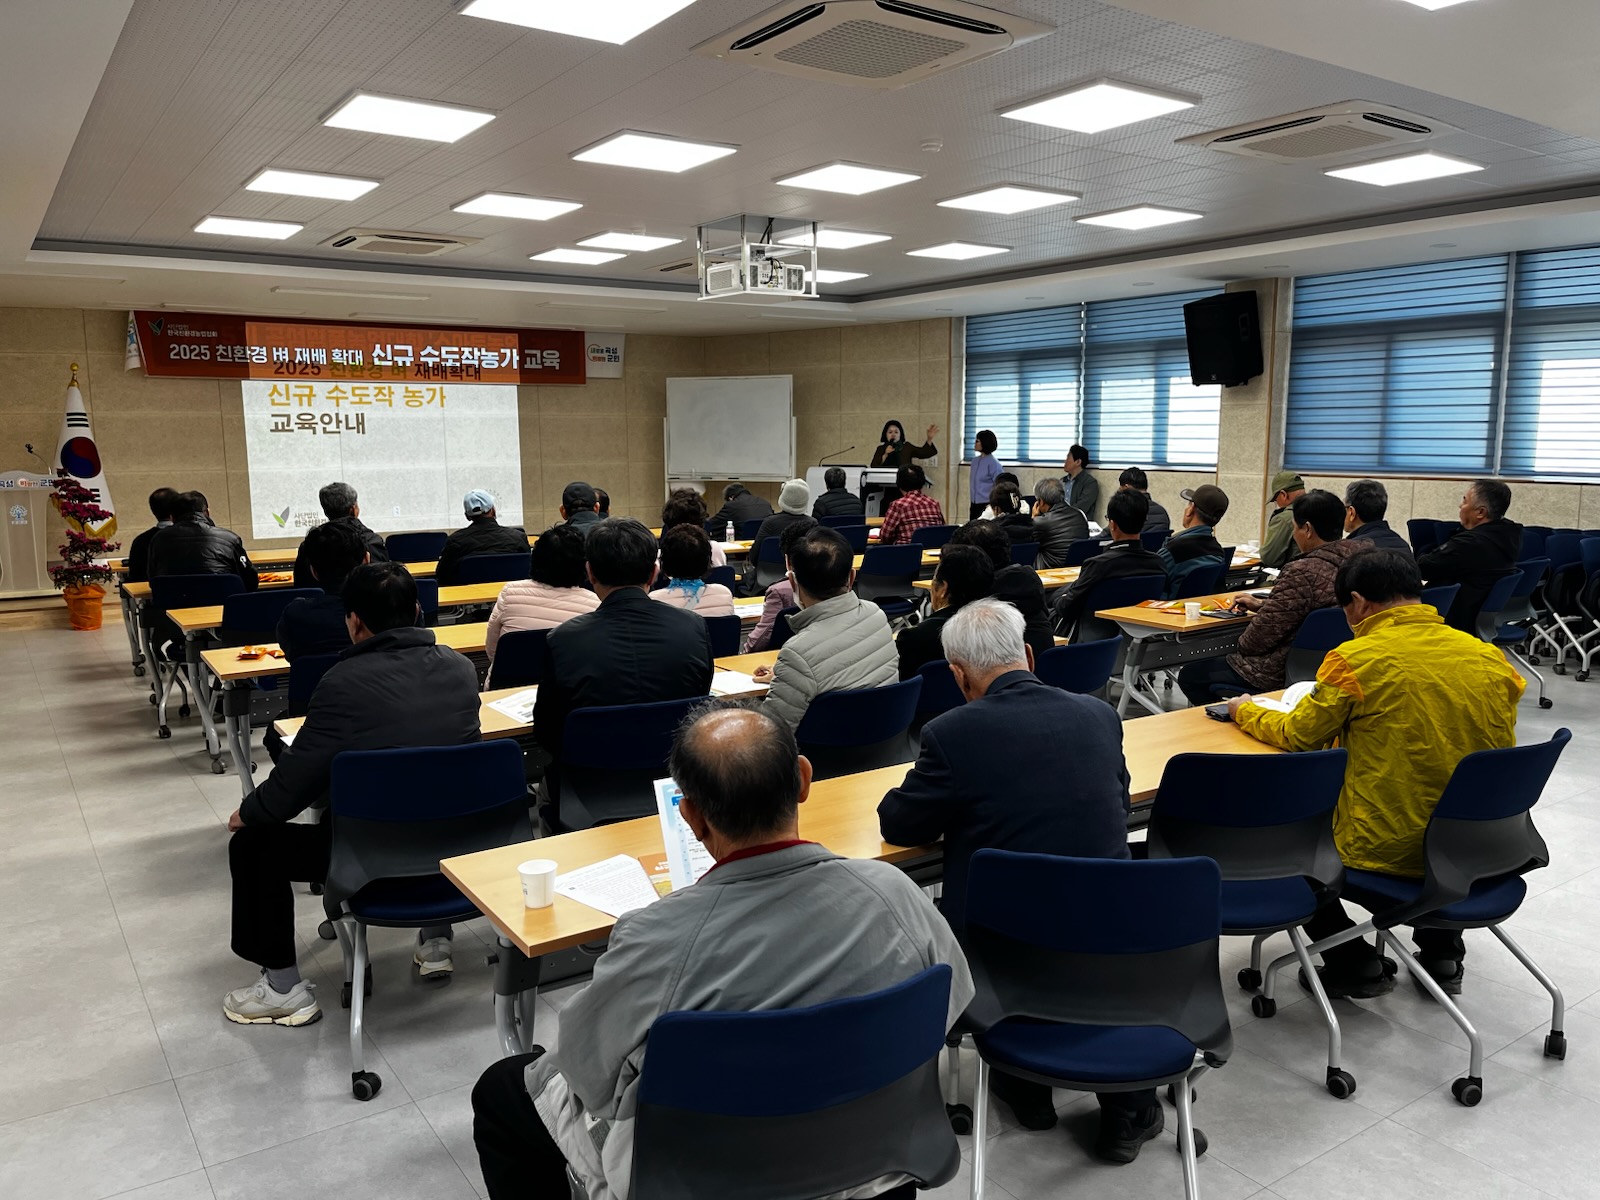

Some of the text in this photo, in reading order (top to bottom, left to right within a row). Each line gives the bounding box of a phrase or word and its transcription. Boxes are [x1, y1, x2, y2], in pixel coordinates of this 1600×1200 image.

[169, 343, 560, 370] 2025 친환경 벼 재배 확대 신규 수도작농가 교육
[273, 359, 321, 376] 2025
[415, 362, 480, 381] 재배확대
[268, 384, 446, 408] 신규 수도작 농가
[270, 412, 366, 435] 교육안내
